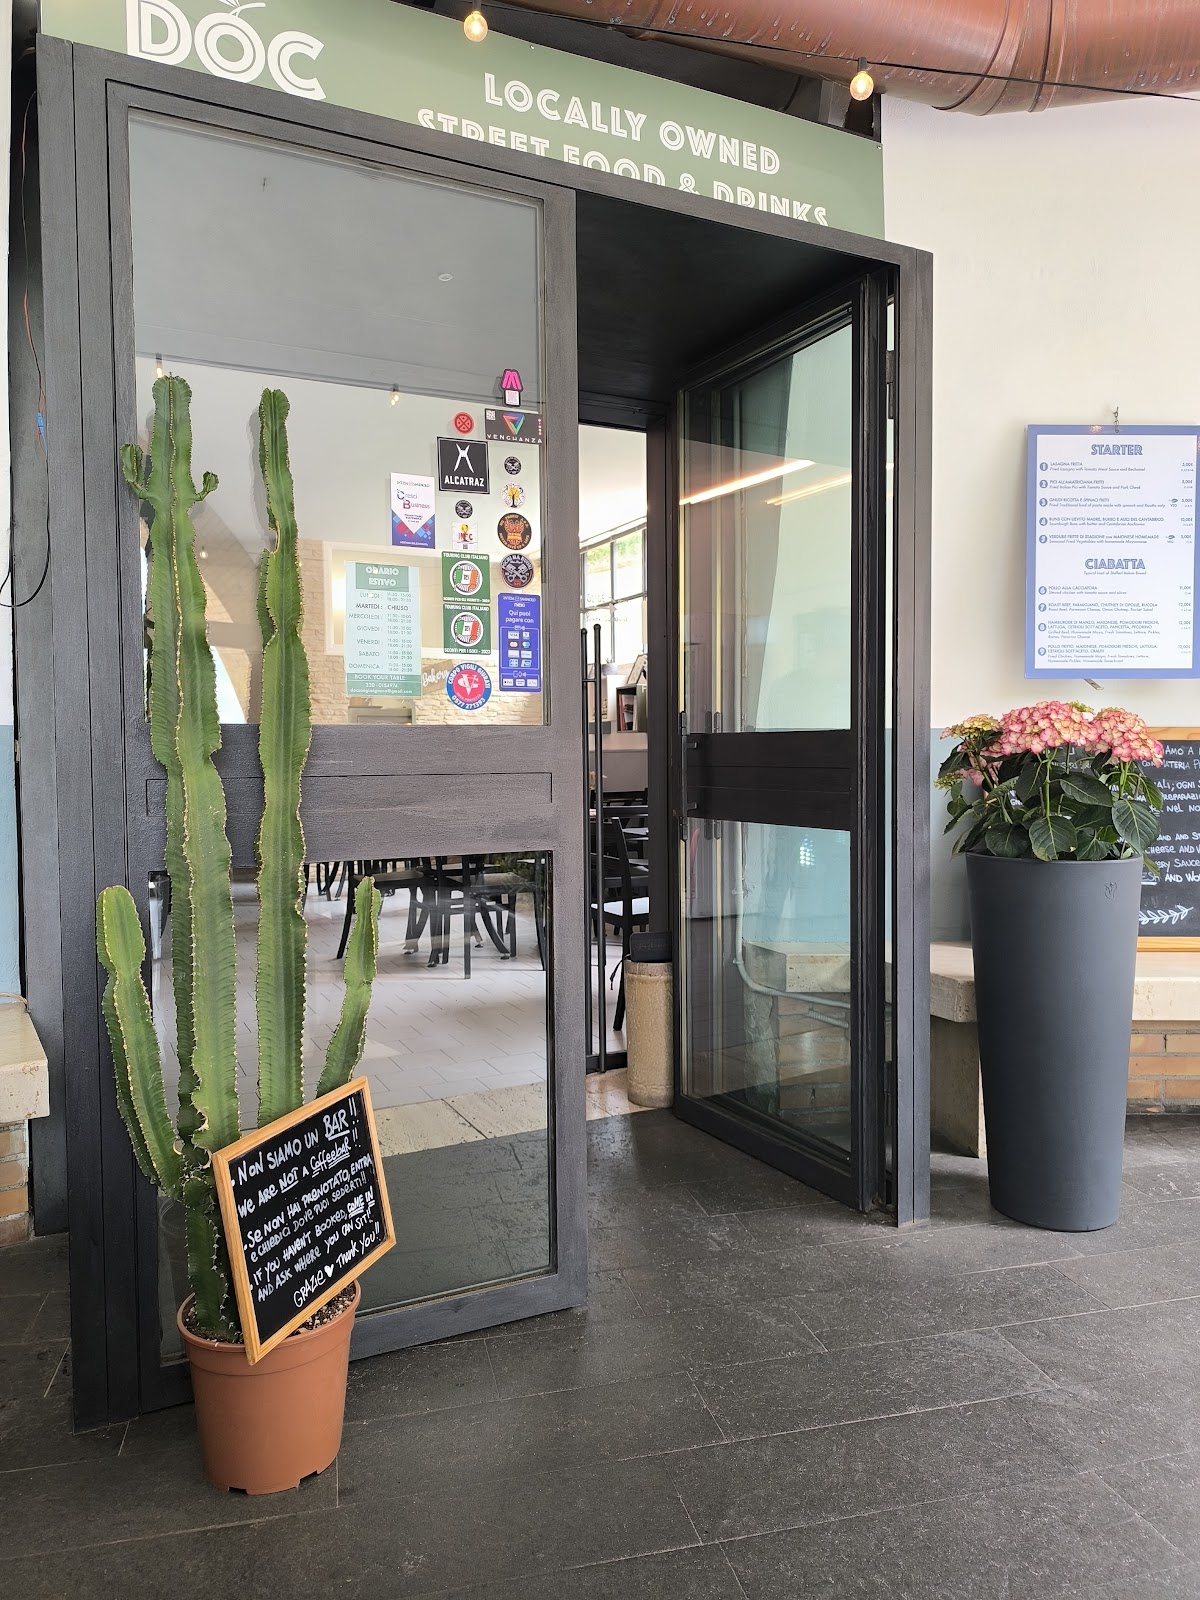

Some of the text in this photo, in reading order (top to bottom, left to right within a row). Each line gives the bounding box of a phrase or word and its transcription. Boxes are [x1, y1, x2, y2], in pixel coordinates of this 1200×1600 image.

[126, 0, 326, 100] DOC
[485, 72, 780, 176] LOCALLY OWNED
[1091, 444, 1143, 455] STARTER
[444, 475, 484, 487] ALCATRAZ
[366, 566, 399, 575] ORARIO
[1085, 559, 1145, 569] CIABATTA
[369, 578, 396, 586] ESTIVO
[448, 667, 460, 684] CORPO
[477, 667, 490, 688] GIURATI
[452, 695, 485, 709] 0577 271393
[1179, 845, 1195, 853] AND
[1165, 873, 1183, 882] AND
[266, 1138, 302, 1170] SIAMO
[304, 1129, 319, 1149] UN
[279, 1167, 298, 1191] NOT
[303, 1166, 309, 1177] A
[287, 1202, 301, 1219] HAI
[253, 1268, 262, 1286] IF
[365, 1185, 373, 1202] IN
[258, 1283, 274, 1302] AND
[276, 1268, 293, 1289] ASK
[342, 1220, 354, 1236] CAN
